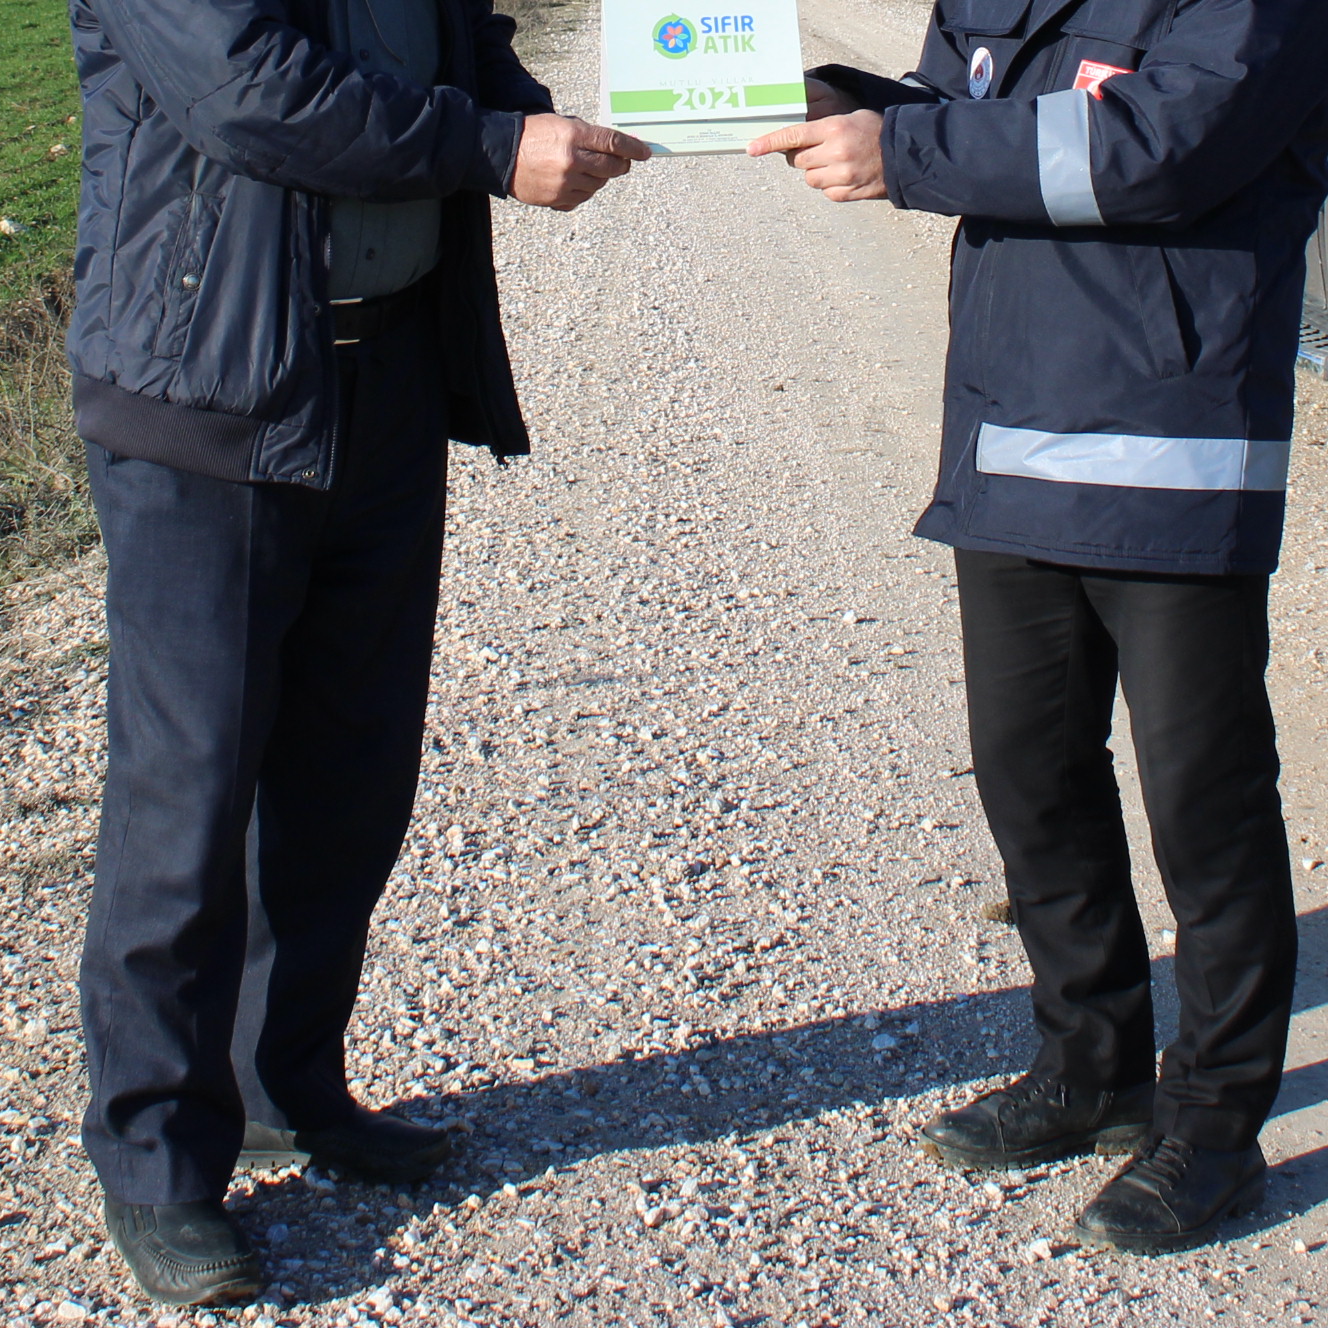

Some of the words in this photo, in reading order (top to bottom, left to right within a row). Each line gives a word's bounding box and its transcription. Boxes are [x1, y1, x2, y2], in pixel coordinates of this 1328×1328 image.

[700, 15, 754, 34] SIFIR
[703, 34, 756, 54] ATIK
[659, 78, 701, 87] MUTLU
[711, 75, 754, 85] YILLAR
[673, 86, 746, 111] 2021
